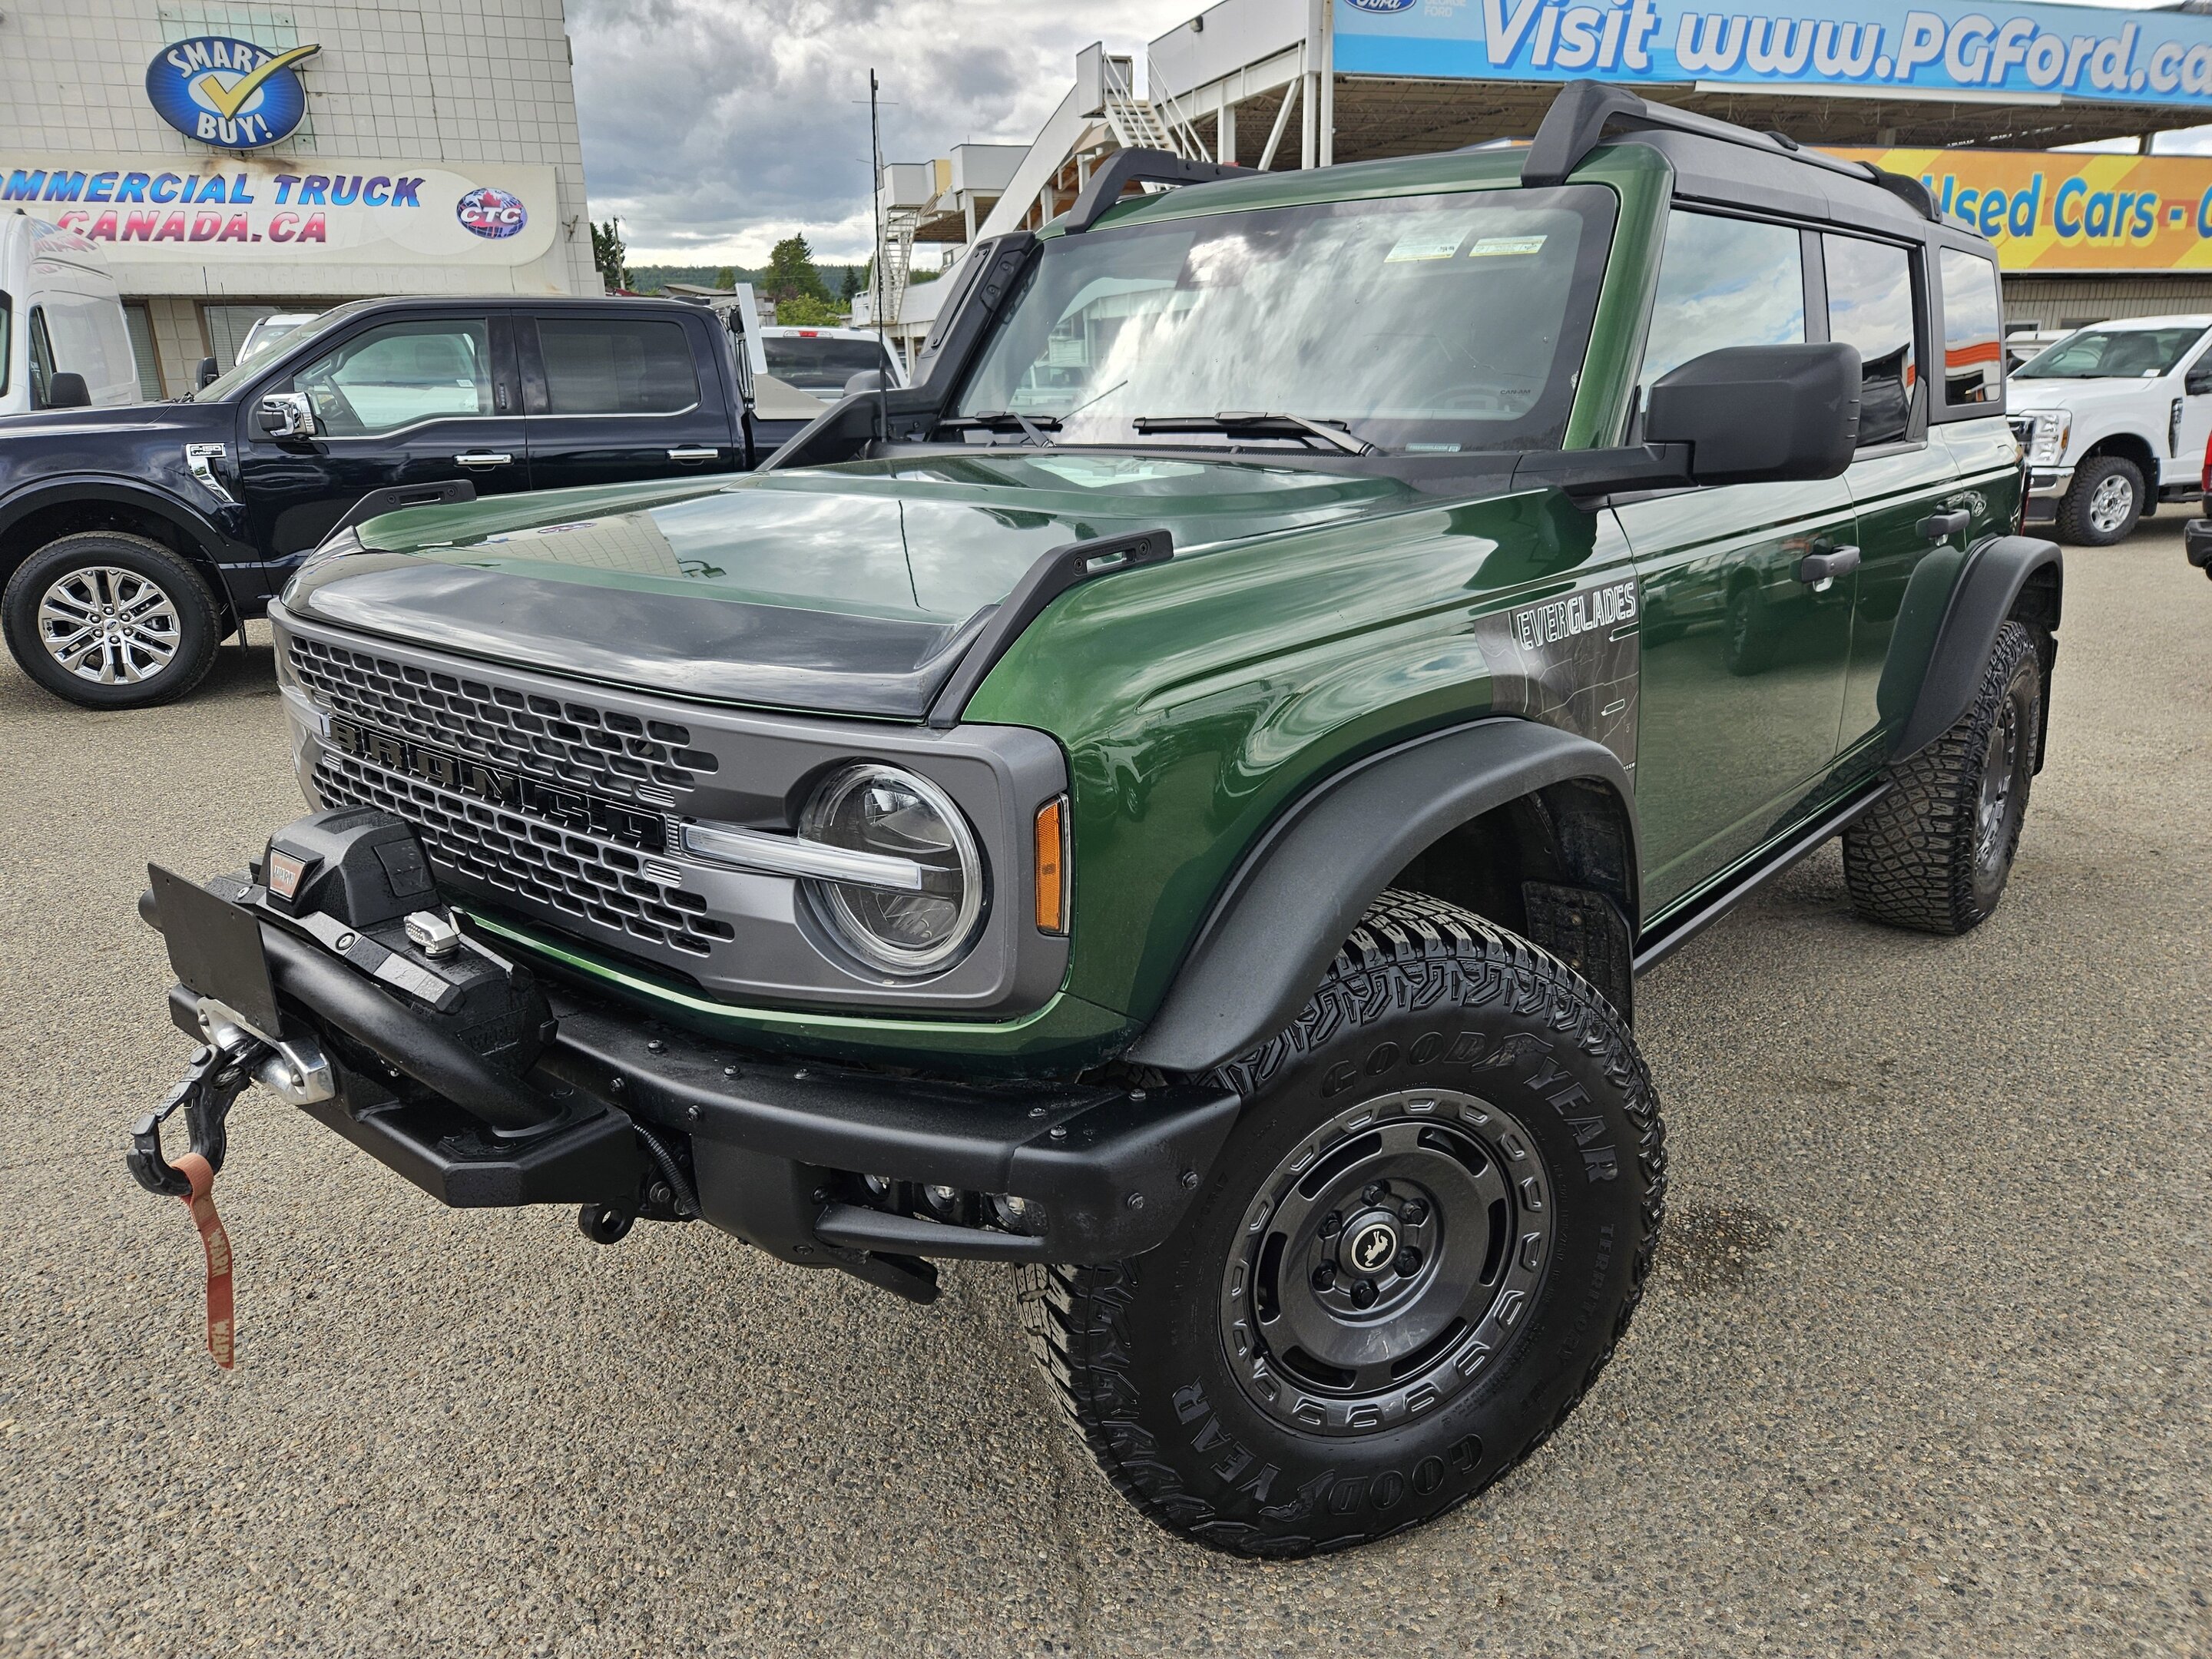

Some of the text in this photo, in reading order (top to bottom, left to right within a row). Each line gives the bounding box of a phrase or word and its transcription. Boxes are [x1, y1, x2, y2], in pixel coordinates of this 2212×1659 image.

[1424, 6, 1452, 18] FORD
[1482, 0, 1656, 70] Visit
[167, 41, 273, 78] SMART
[197, 111, 273, 144] BUY!
[0, 169, 426, 207] MMERCIAL TRUCK
[1921, 171, 2045, 237] Used
[2054, 176, 2158, 239] Cars
[57, 210, 326, 243] CANADA.CA
[460, 206, 522, 224] CTC
[1516, 581, 1636, 651] EVERGLADES
[330, 716, 667, 846] BRONCO
[1320, 1030, 1621, 1184] GOODYEAR
[207, 1228, 230, 1279] WARN
[1558, 1224, 1616, 1366] TERRITORY
[211, 1318, 230, 1363] WARN
[1171, 1374, 1485, 1523] GOODYEAR
